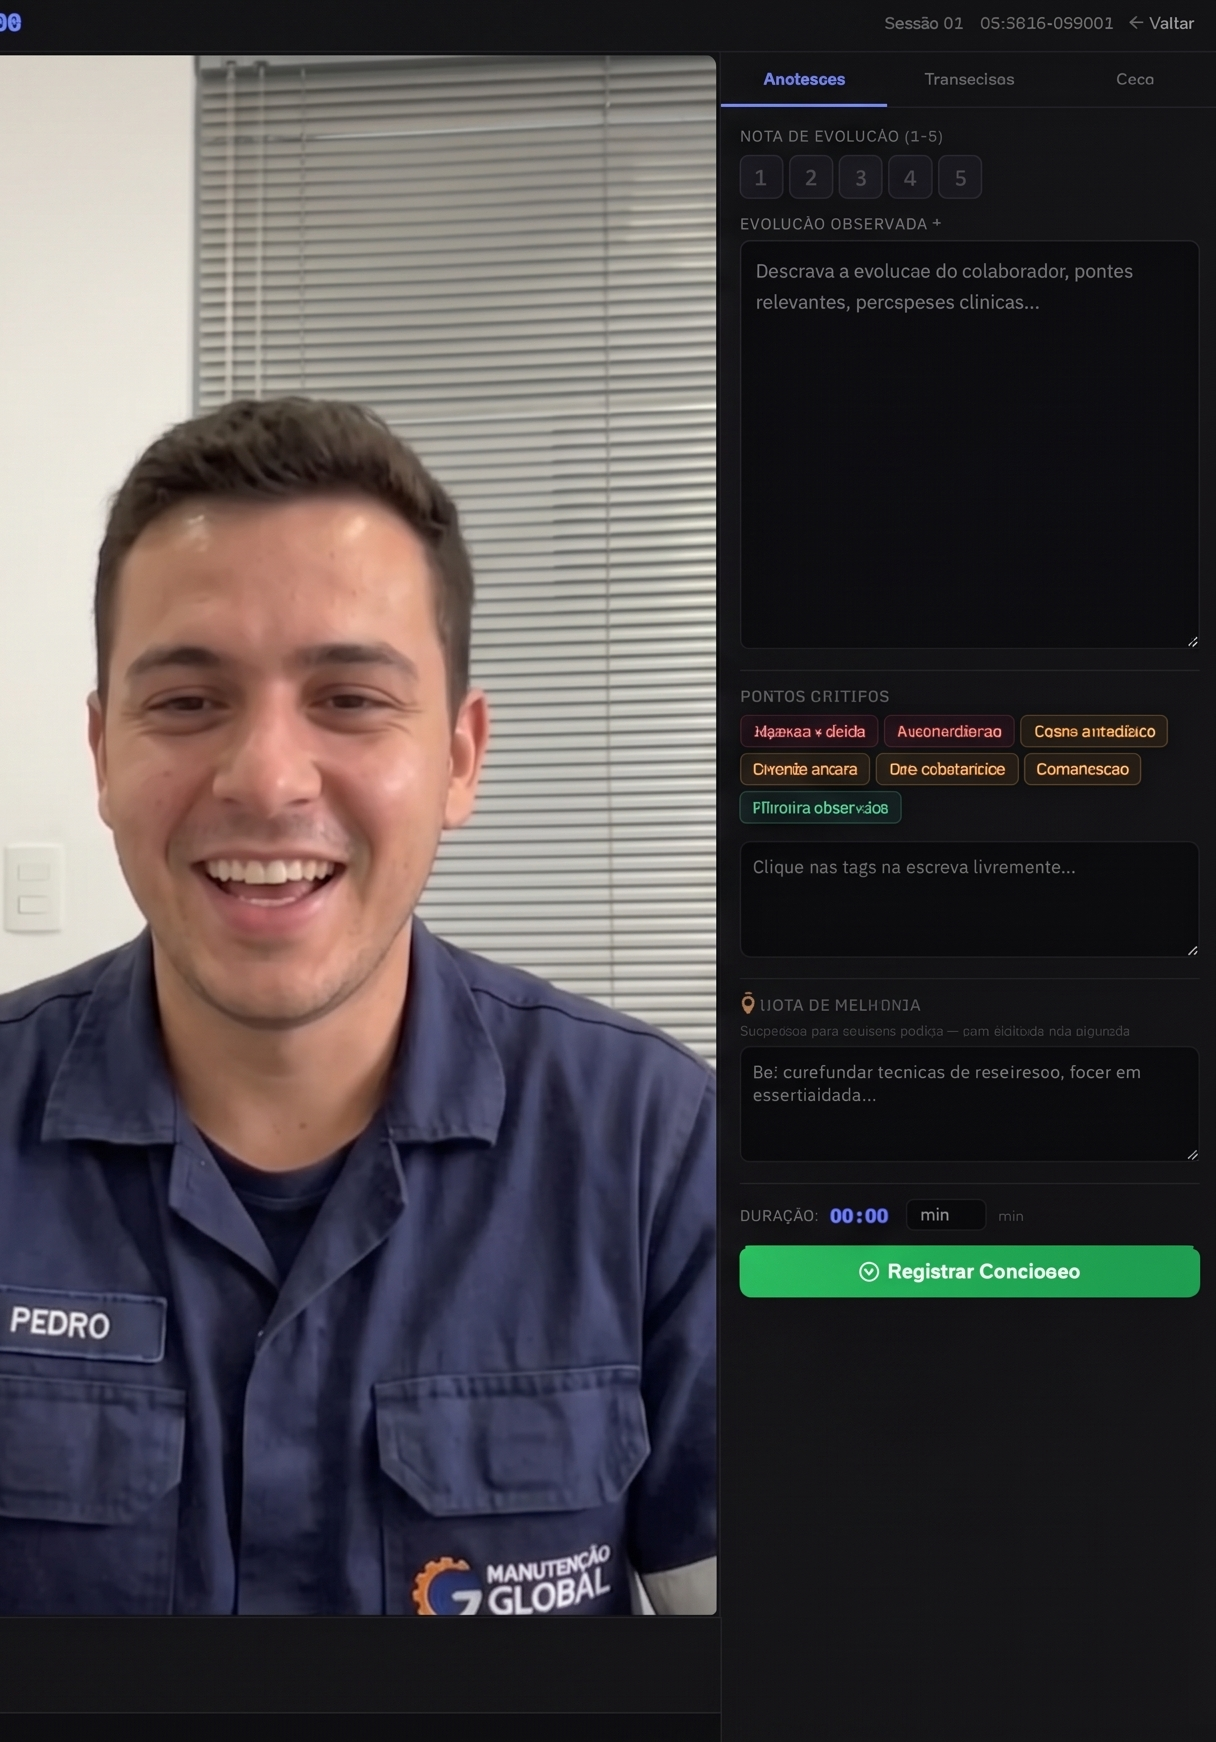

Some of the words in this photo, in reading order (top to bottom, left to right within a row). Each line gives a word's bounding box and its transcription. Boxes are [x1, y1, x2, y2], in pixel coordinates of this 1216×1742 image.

[884, 16, 939, 30] Sessão
[943, 16, 964, 30] 01
[1149, 16, 1195, 30] Valtar
[740, 129, 784, 143] NOTA
[788, 129, 809, 143] DE
[904, 130, 943, 146] (1-5)
[755, 169, 767, 187] 1
[805, 169, 817, 187] 2
[855, 169, 867, 187] 3
[903, 169, 917, 187] 4
[955, 169, 967, 187] 5
[830, 217, 928, 231] OBSERVADA
[756, 263, 835, 279] Descrava
[839, 266, 850, 279] a
[853, 262, 931, 279] evolucae
[935, 262, 958, 279] do
[962, 262, 1069, 282] colaborador,
[1074, 264, 1134, 284] pontes
[756, 293, 851, 313] relevantes,
[856, 297, 955, 314] percspeses
[959, 293, 1040, 310] clinicas...
[740, 689, 806, 703] PONTOS
[753, 858, 804, 878] Clique
[810, 862, 838, 875] nas
[842, 860, 877, 878] tags
[881, 862, 901, 875] na
[906, 862, 969, 875] escreva
[973, 858, 1076, 875] livremente...
[809, 998, 830, 1012] DE
[811, 1027, 839, 1039] para
[783, 1064, 874, 1080] curefundar
[878, 1064, 946, 1080] tecnicas
[950, 1064, 970, 1080] de
[1070, 1064, 1112, 1080] focer
[1116, 1068, 1141, 1080] em
[740, 1207, 819, 1226] DURAÇÃO:
[829, 1207, 889, 1225] 00:00
[920, 1207, 950, 1222] min
[998, 1209, 1025, 1223] min
[888, 1262, 975, 1284] Registrar
[10, 1306, 111, 1340] PEDRO
[486, 1544, 611, 1584] MANUTENÇÃO
[487, 1566, 611, 1615] GLOBAL
